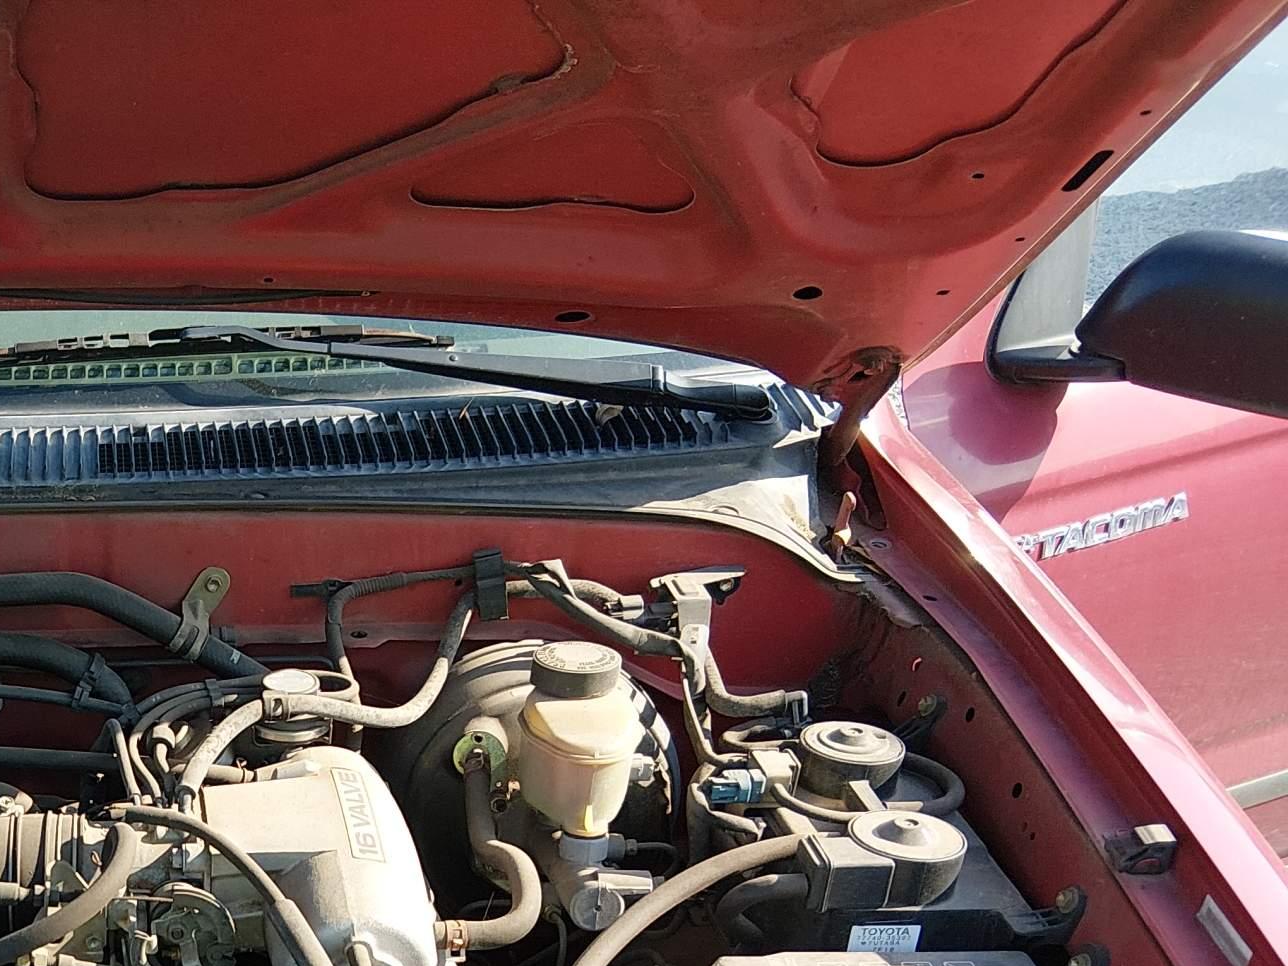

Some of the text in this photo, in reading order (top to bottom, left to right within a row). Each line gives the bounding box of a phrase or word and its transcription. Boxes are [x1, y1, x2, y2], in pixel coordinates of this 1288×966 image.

[1038, 491, 1189, 560] TACOMA
[337, 771, 379, 855] 16 VALVE
[861, 927, 910, 936] TOYOTA
